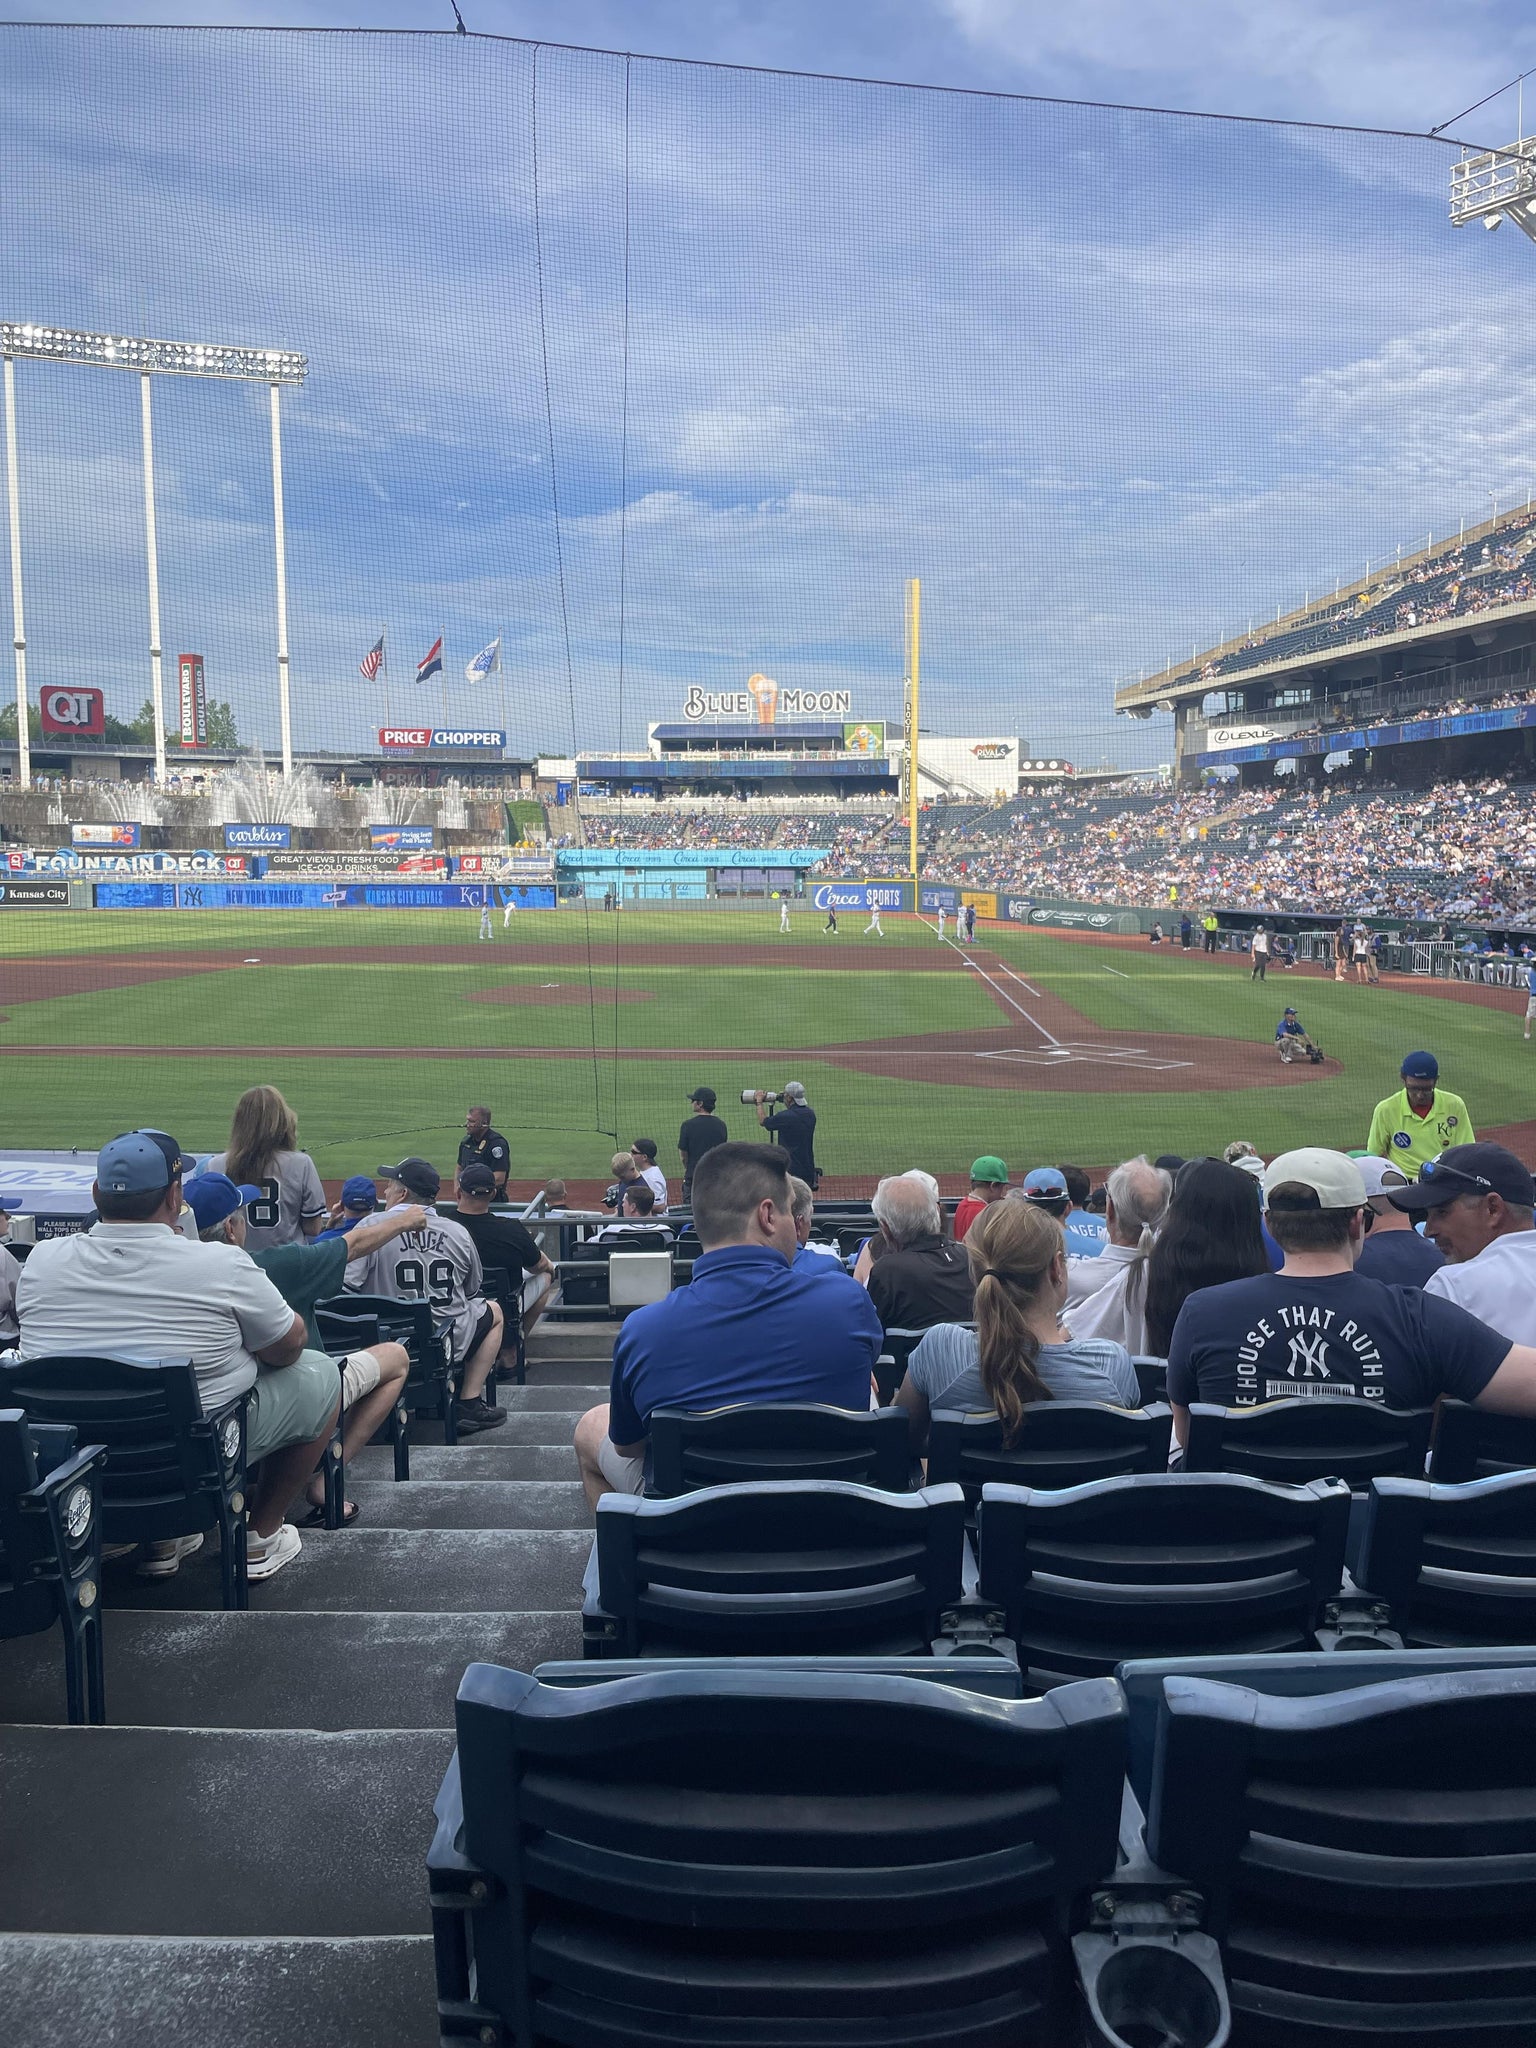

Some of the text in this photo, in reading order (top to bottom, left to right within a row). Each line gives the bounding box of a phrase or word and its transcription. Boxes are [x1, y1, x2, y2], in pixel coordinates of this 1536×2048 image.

[48, 691, 93, 726] QT
[182, 669, 192, 736] BOULEVARD
[196, 671, 206, 737] BOULEVARD
[684, 686, 850, 720] BLUE MOON
[384, 732, 501, 745] PRICE CHOPPER
[1231, 730, 1274, 740] LEXUS
[978, 748, 1006, 756] RIVALS
[229, 826, 286, 841] carbliss
[35, 856, 222, 872] FOUNTAIN DECK
[228, 859, 242, 869] QT
[341, 856, 372, 864] FRESH
[374, 856, 399, 864] FOOD
[463, 859, 477, 869] QT
[616, 851, 641, 865] Circa
[674, 851, 699, 865] Circa
[731, 851, 756, 865] Circa
[345, 864, 379, 872] DRINKS
[661, 878, 689, 894] Cica
[9, 889, 67, 900] Kansas City
[184, 886, 203, 906] NY
[226, 890, 303, 904] NEW YORK YANKEES
[366, 890, 396, 904] KANSAS
[398, 890, 414, 904] CITY
[460, 886, 480, 907] KC
[815, 885, 861, 909] Circa
[866, 889, 900, 906] SPORTS
[0, 1169, 97, 1186] 024
[395, 1259, 454, 1308] 99
[1237, 1305, 1384, 1389] HOUSE THAT RUTH
[1287, 1330, 1331, 1379] NY
